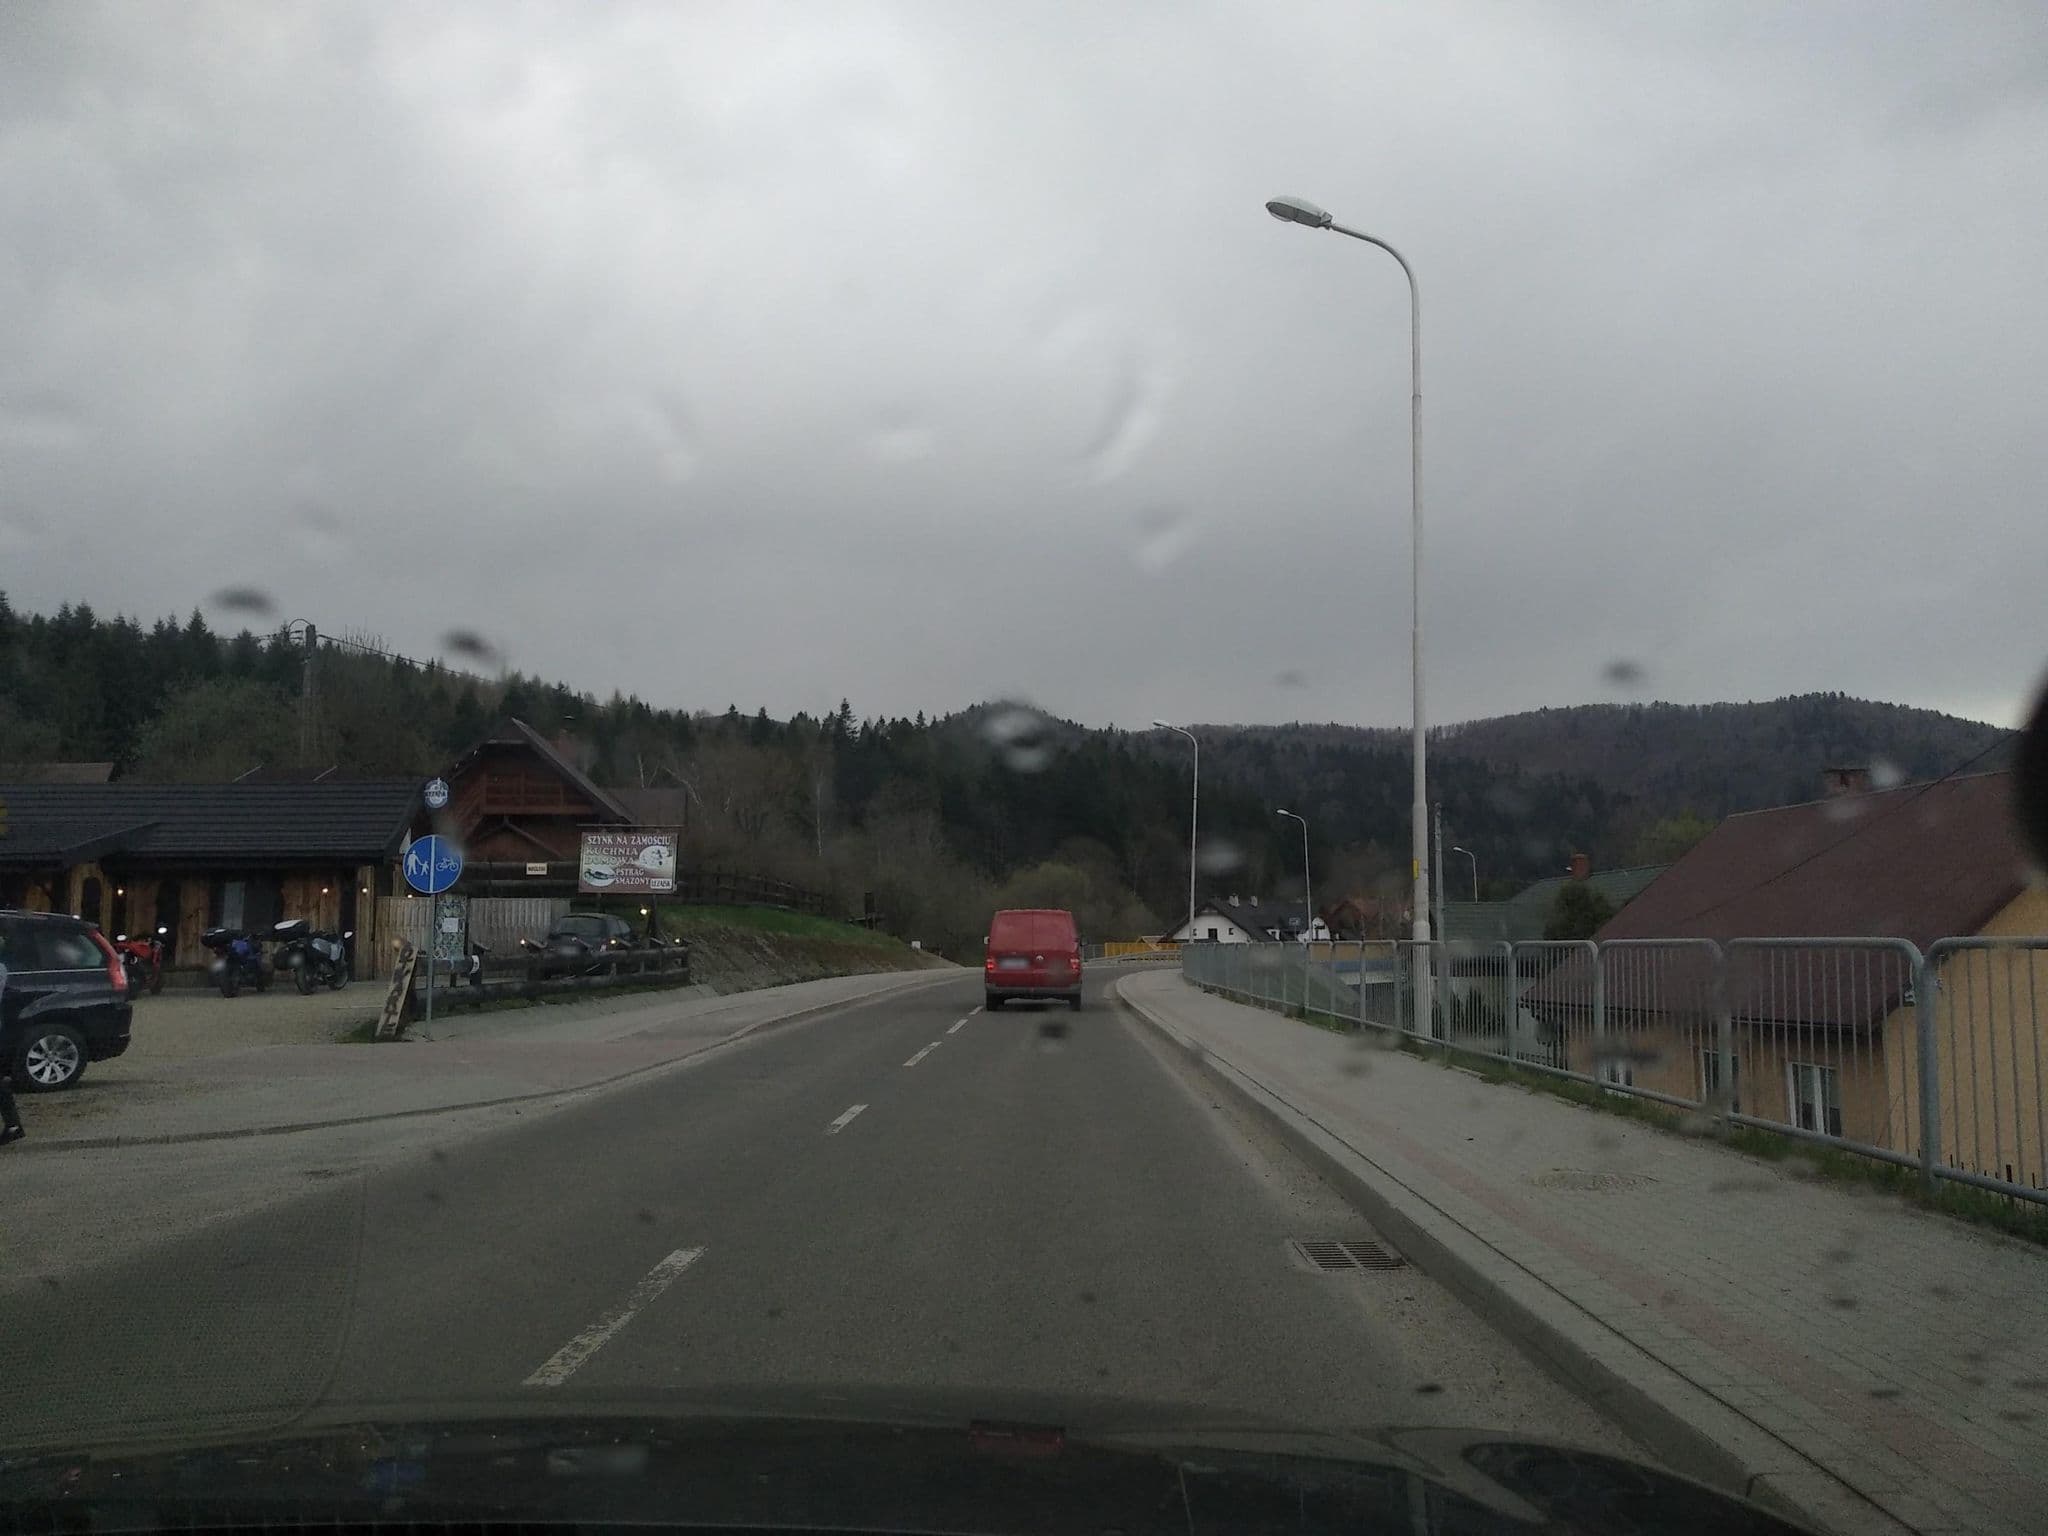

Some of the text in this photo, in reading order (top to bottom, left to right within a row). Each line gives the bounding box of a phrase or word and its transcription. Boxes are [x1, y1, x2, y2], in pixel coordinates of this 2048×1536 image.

[616, 836, 628, 845] NA
[585, 847, 639, 856] KUCHNIA
[584, 856, 634, 865] DOMOWA
